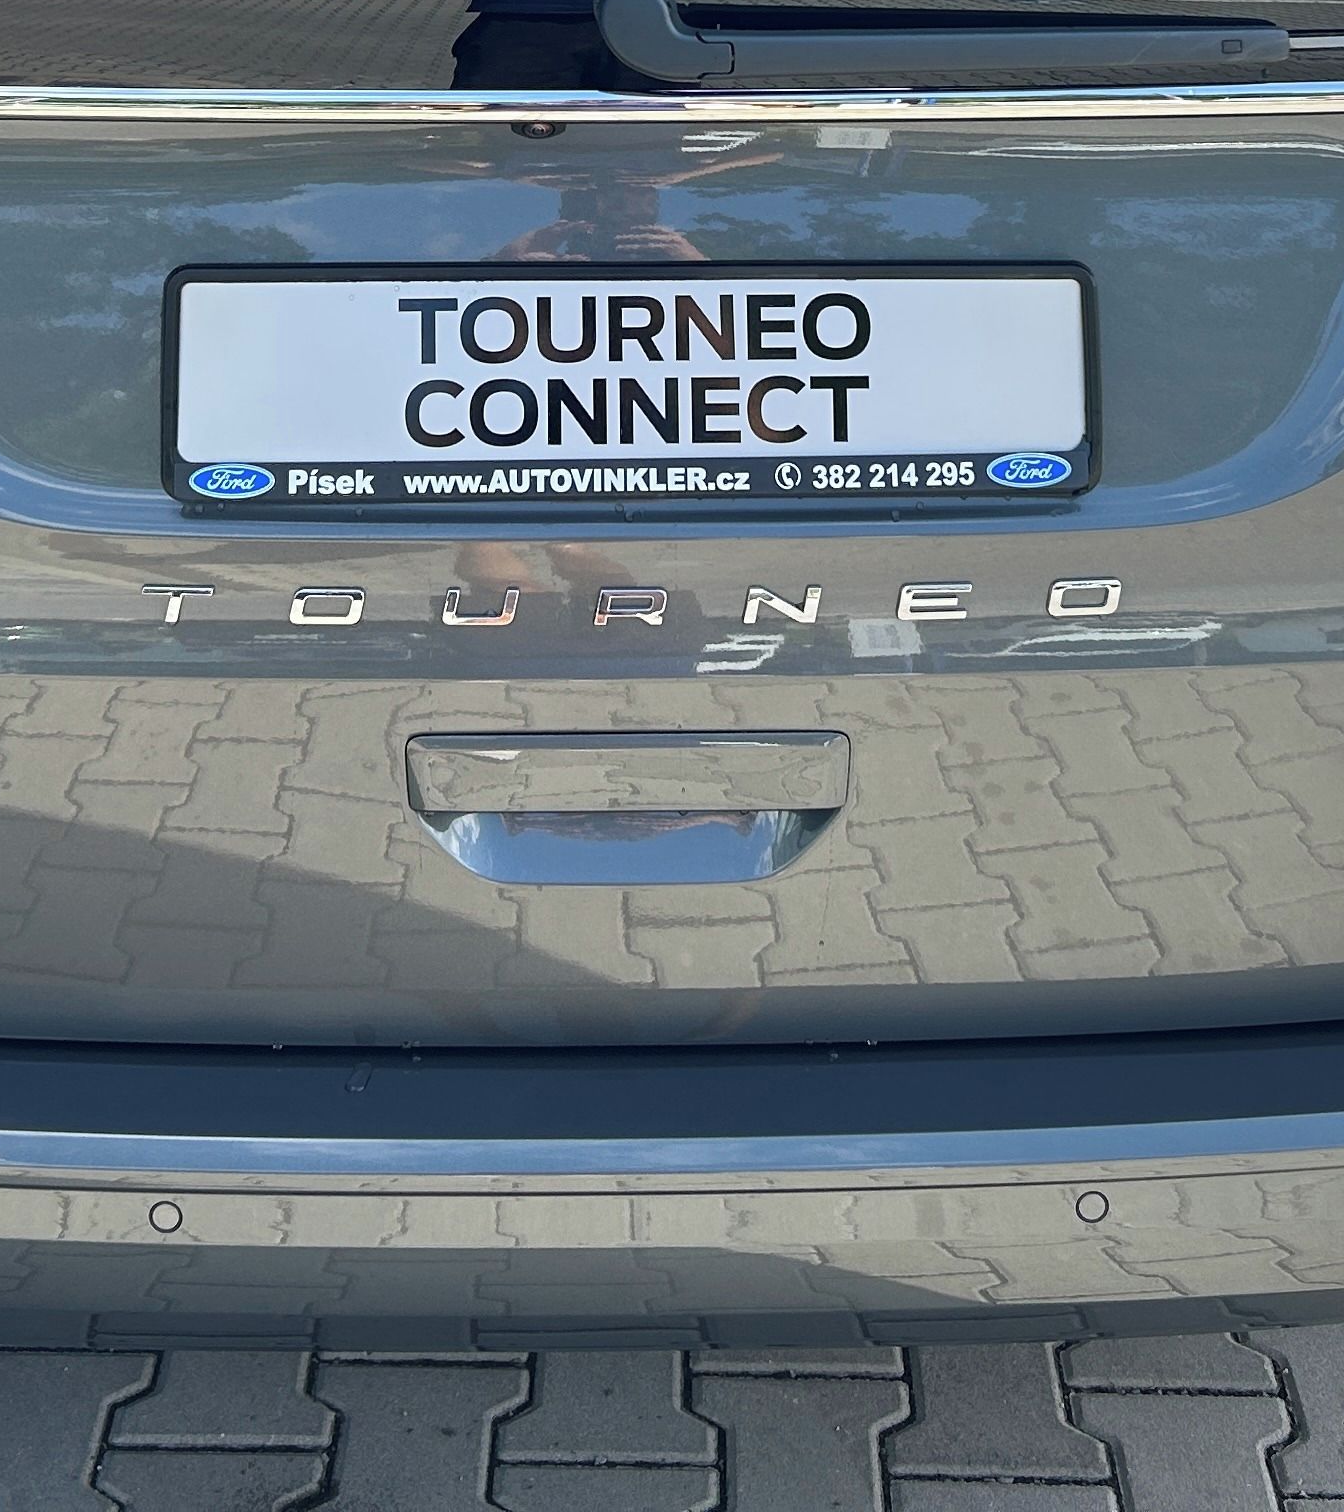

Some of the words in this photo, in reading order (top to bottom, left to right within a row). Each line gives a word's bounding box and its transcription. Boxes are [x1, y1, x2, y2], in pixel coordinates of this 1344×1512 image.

[399, 294, 871, 365] TOURNEO
[404, 376, 869, 448] CONNECT
[288, 469, 375, 495] Písek
[403, 466, 750, 494] www.AUTOVINKLER.cz
[812, 464, 861, 489] 382
[870, 464, 919, 488] 214
[925, 461, 975, 487] 295
[141, 577, 1123, 627] TOURNEO
